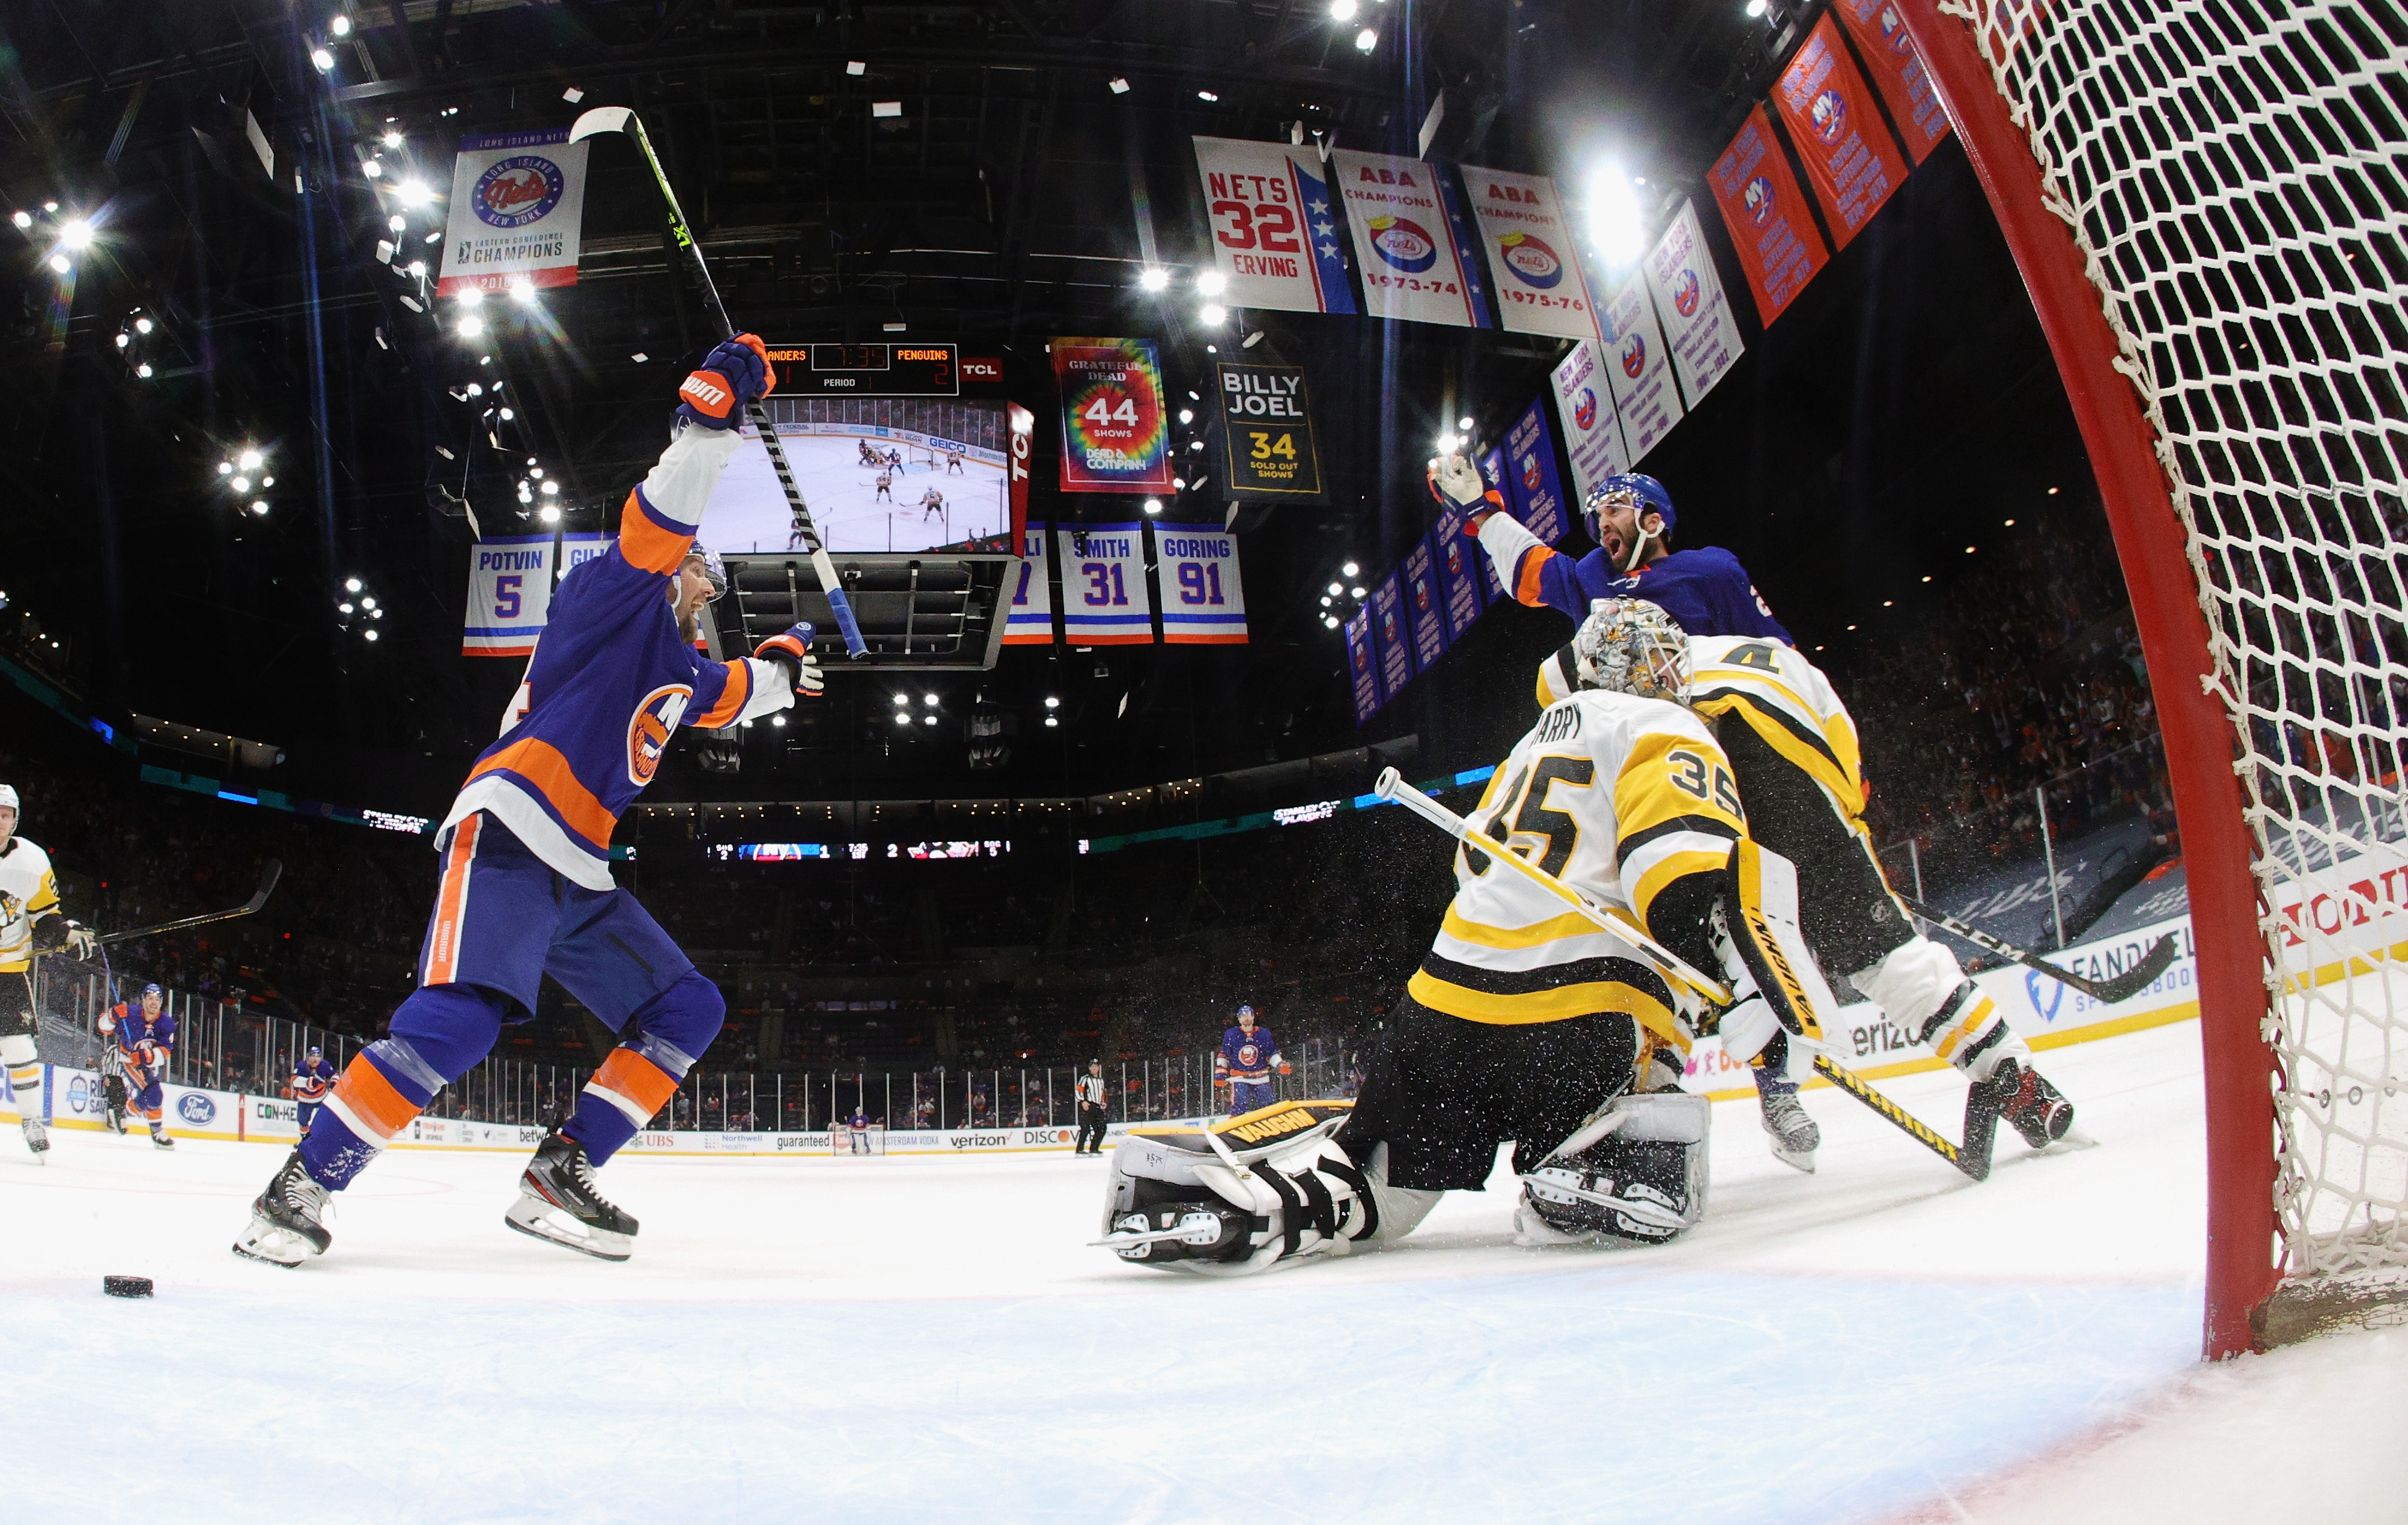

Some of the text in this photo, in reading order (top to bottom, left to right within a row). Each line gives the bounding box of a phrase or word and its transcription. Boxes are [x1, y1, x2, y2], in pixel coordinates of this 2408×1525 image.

[479, 136, 503, 148] LONG
[507, 133, 541, 145] ISLAND
[484, 156, 554, 180] LONG ISLAND
[1360, 166, 1417, 187] ABA
[1209, 172, 1288, 203] NETS
[1488, 183, 1540, 205] ABA
[1345, 189, 1434, 209] CHAMPIONS
[487, 207, 543, 226] NEW YORK
[1476, 205, 1556, 225] CHAMPIONS
[1212, 200, 1301, 254] 32
[474, 242, 563, 263] CHAMPIONS
[1233, 254, 1298, 278] ERVING
[1367, 272, 1458, 295] 1973-74
[1502, 288, 1584, 311] 1975-76
[766, 350, 805, 361] ANDERS
[898, 350, 948, 361] PENGUINS
[1069, 360, 1143, 371] GRATEFUL
[824, 379, 856, 388] PERIOD
[935, 364, 948, 385] 2
[964, 364, 997, 376] TCL
[1088, 371, 1126, 382] DEAD
[1223, 372, 1300, 395] BILLY
[1085, 398, 1139, 427] 44
[1229, 394, 1304, 417] JOEL
[1093, 429, 1133, 439] SHOWS
[930, 437, 967, 454] GEICO
[1012, 421, 1029, 482] TC
[1086, 448, 1111, 460] DEAD
[1249, 432, 1297, 460] 34
[1086, 458, 1147, 471] COMPANY
[1250, 461, 1298, 470] SOLD OUT
[1257, 470, 1294, 479] SHOWS
[1074, 538, 1130, 558] SMITH
[1164, 538, 1230, 558] GORING
[479, 550, 543, 571] POTVIN
[1082, 562, 1128, 606] 31
[1178, 562, 1225, 606] 91
[494, 574, 523, 619] 5
[1530, 702, 1582, 749] ARRY
[1667, 749, 1747, 832] 35
[720, 851, 728, 860] 2
[819, 845, 830, 859] 1
[848, 844, 869, 852] 7:35
[887, 844, 898, 857] 2
[990, 847, 998, 857] 5
[438, 920, 451, 963] WARRIOR
[1941, 916, 2027, 961] CCM
[1751, 916, 1817, 1027] VAUGHN
[2076, 964, 2198, 1012] SPSBOO
[1849, 1012, 1923, 1056] erizo
[184, 1096, 210, 1119] Ford
[257, 1103, 297, 1122] CON-KE
[519, 1127, 546, 1142] betw
[1229, 1108, 1317, 1143] VAUGHN
[646, 1135, 673, 1147] UBS
[777, 1134, 830, 1150] guaranteed
[919, 1136, 938, 1145] VODKA
[950, 1133, 1006, 1149] verizon
[1024, 1130, 1081, 1143] DISCOV
